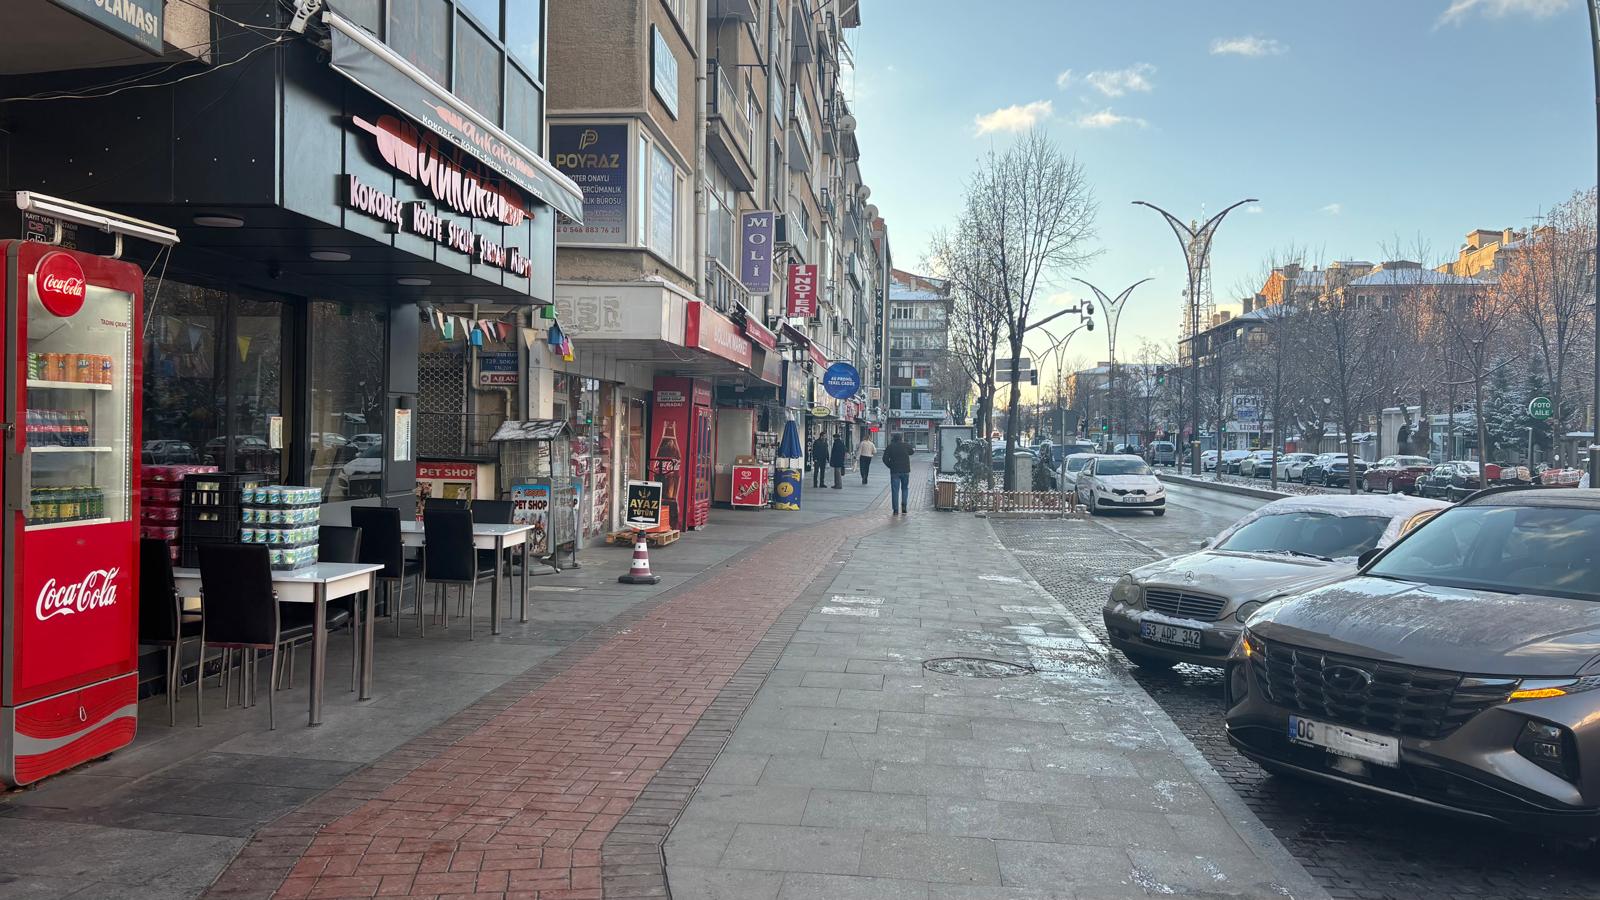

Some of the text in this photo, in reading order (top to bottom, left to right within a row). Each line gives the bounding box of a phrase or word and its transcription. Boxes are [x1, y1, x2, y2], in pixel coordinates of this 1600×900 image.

[556, 153, 619, 168] POYRAZ
[587, 174, 610, 182] ONAYLI
[350, 175, 403, 233] KOKOREÇ
[413, 201, 442, 242] KÖFTE
[448, 222, 475, 256] SUCUK
[43, 273, 83, 297] Coca-Cola
[420, 468, 476, 477] PET SHOP
[515, 499, 547, 510] PET SHOP
[630, 498, 658, 510] AYAZ
[633, 509, 653, 517] TÜTÜN
[35, 566, 120, 621] Coca-Cola
[1146, 622, 1200, 645] 53 ADP 342
[1297, 719, 1315, 741] 06
